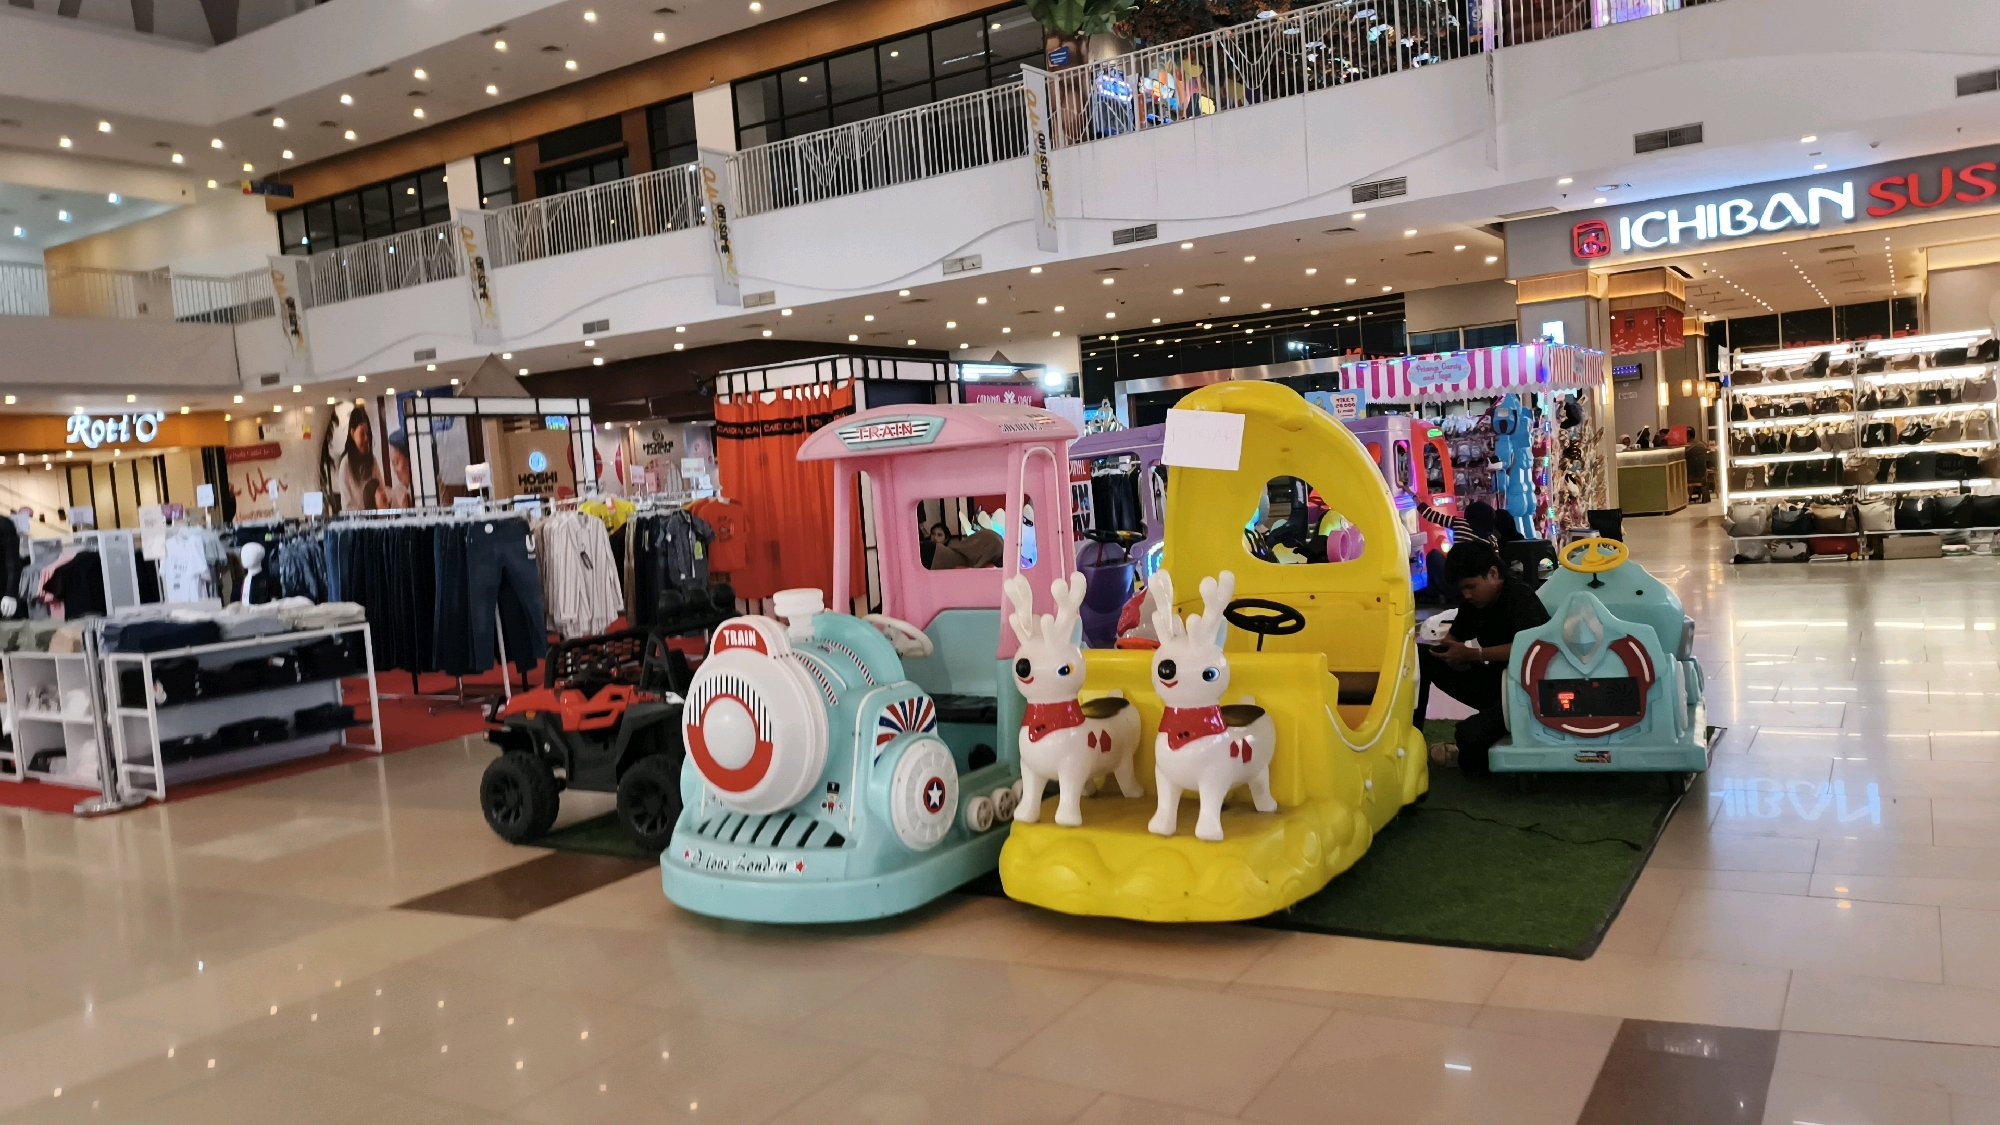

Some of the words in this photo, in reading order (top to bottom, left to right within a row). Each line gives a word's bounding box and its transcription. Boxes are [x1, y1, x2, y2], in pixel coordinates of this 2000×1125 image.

[1619, 181, 1854, 250] ICHIBAN
[1866, 162, 1997, 217] SUS
[1422, 372, 1435, 381] and
[856, 422, 914, 440] TRAIN
[517, 471, 558, 487] HOSHI
[723, 629, 757, 647] TRAIN
[735, 851, 788, 873] London
